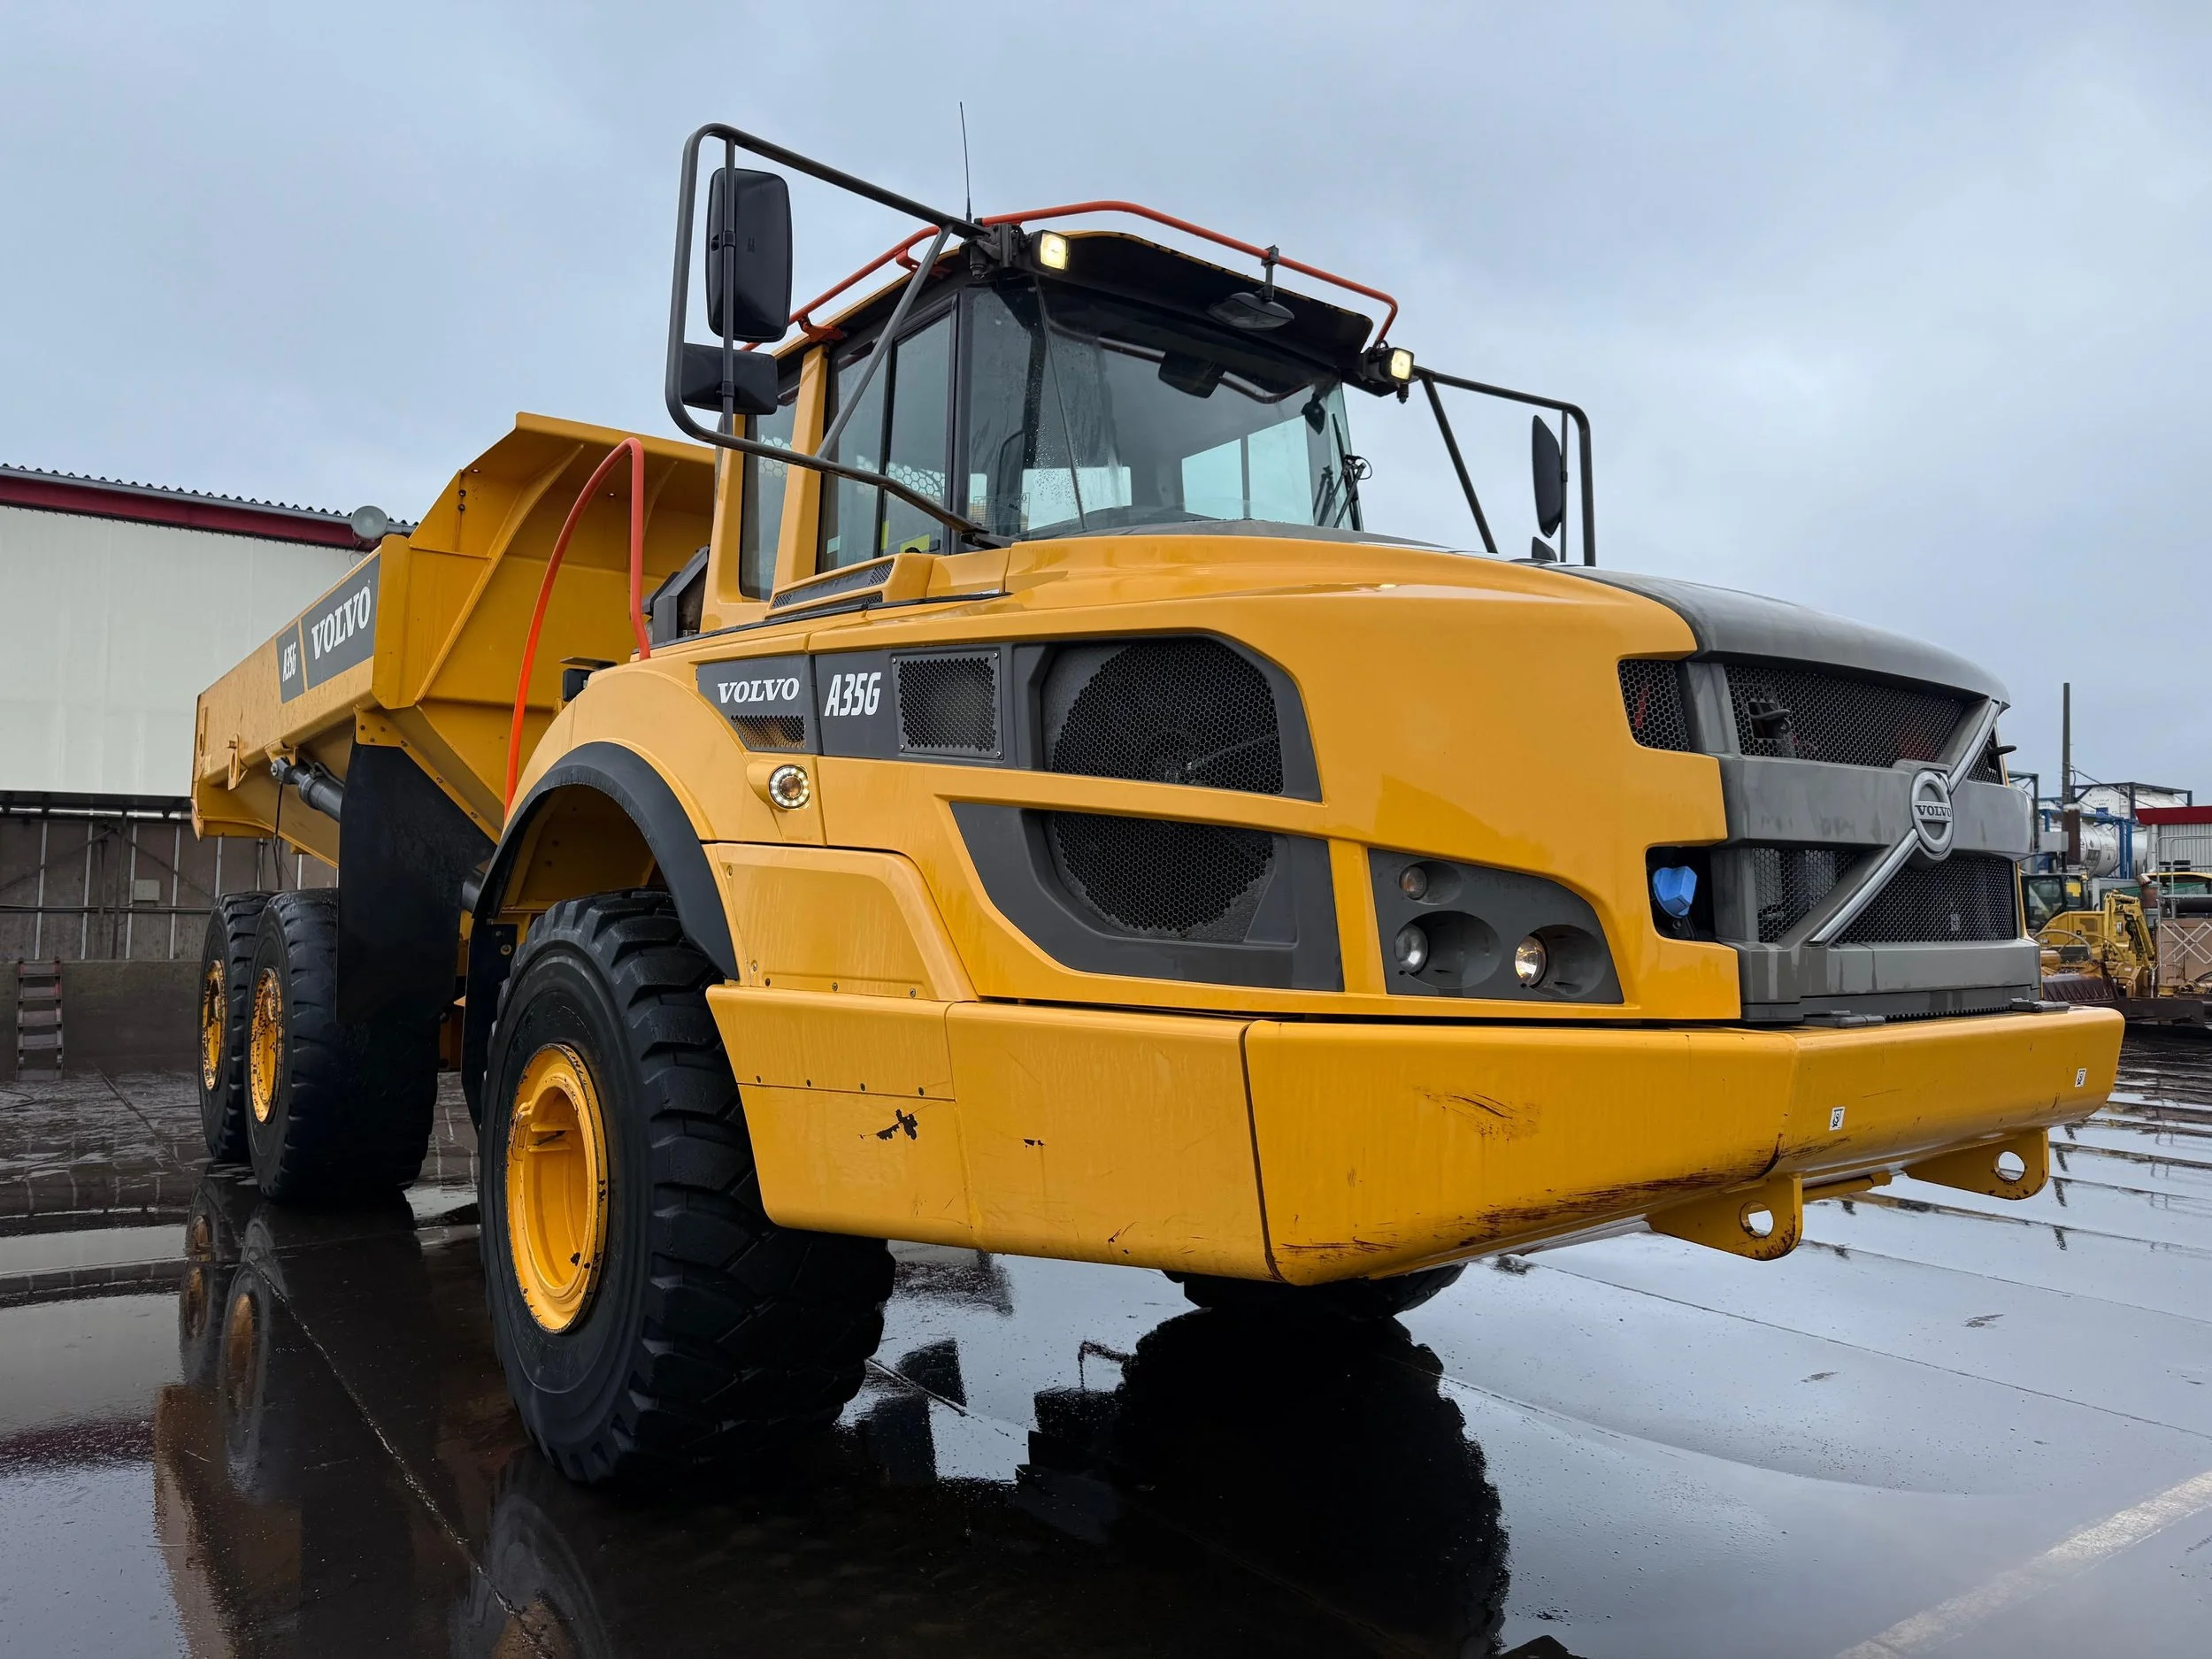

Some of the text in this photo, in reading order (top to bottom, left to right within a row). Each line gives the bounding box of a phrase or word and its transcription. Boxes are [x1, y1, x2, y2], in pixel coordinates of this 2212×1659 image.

[311, 586, 371, 660] VOLVO
[718, 678, 800, 703] VOLVO
[824, 672, 882, 717] A35G
[1915, 804, 1952, 817] VOLVO
